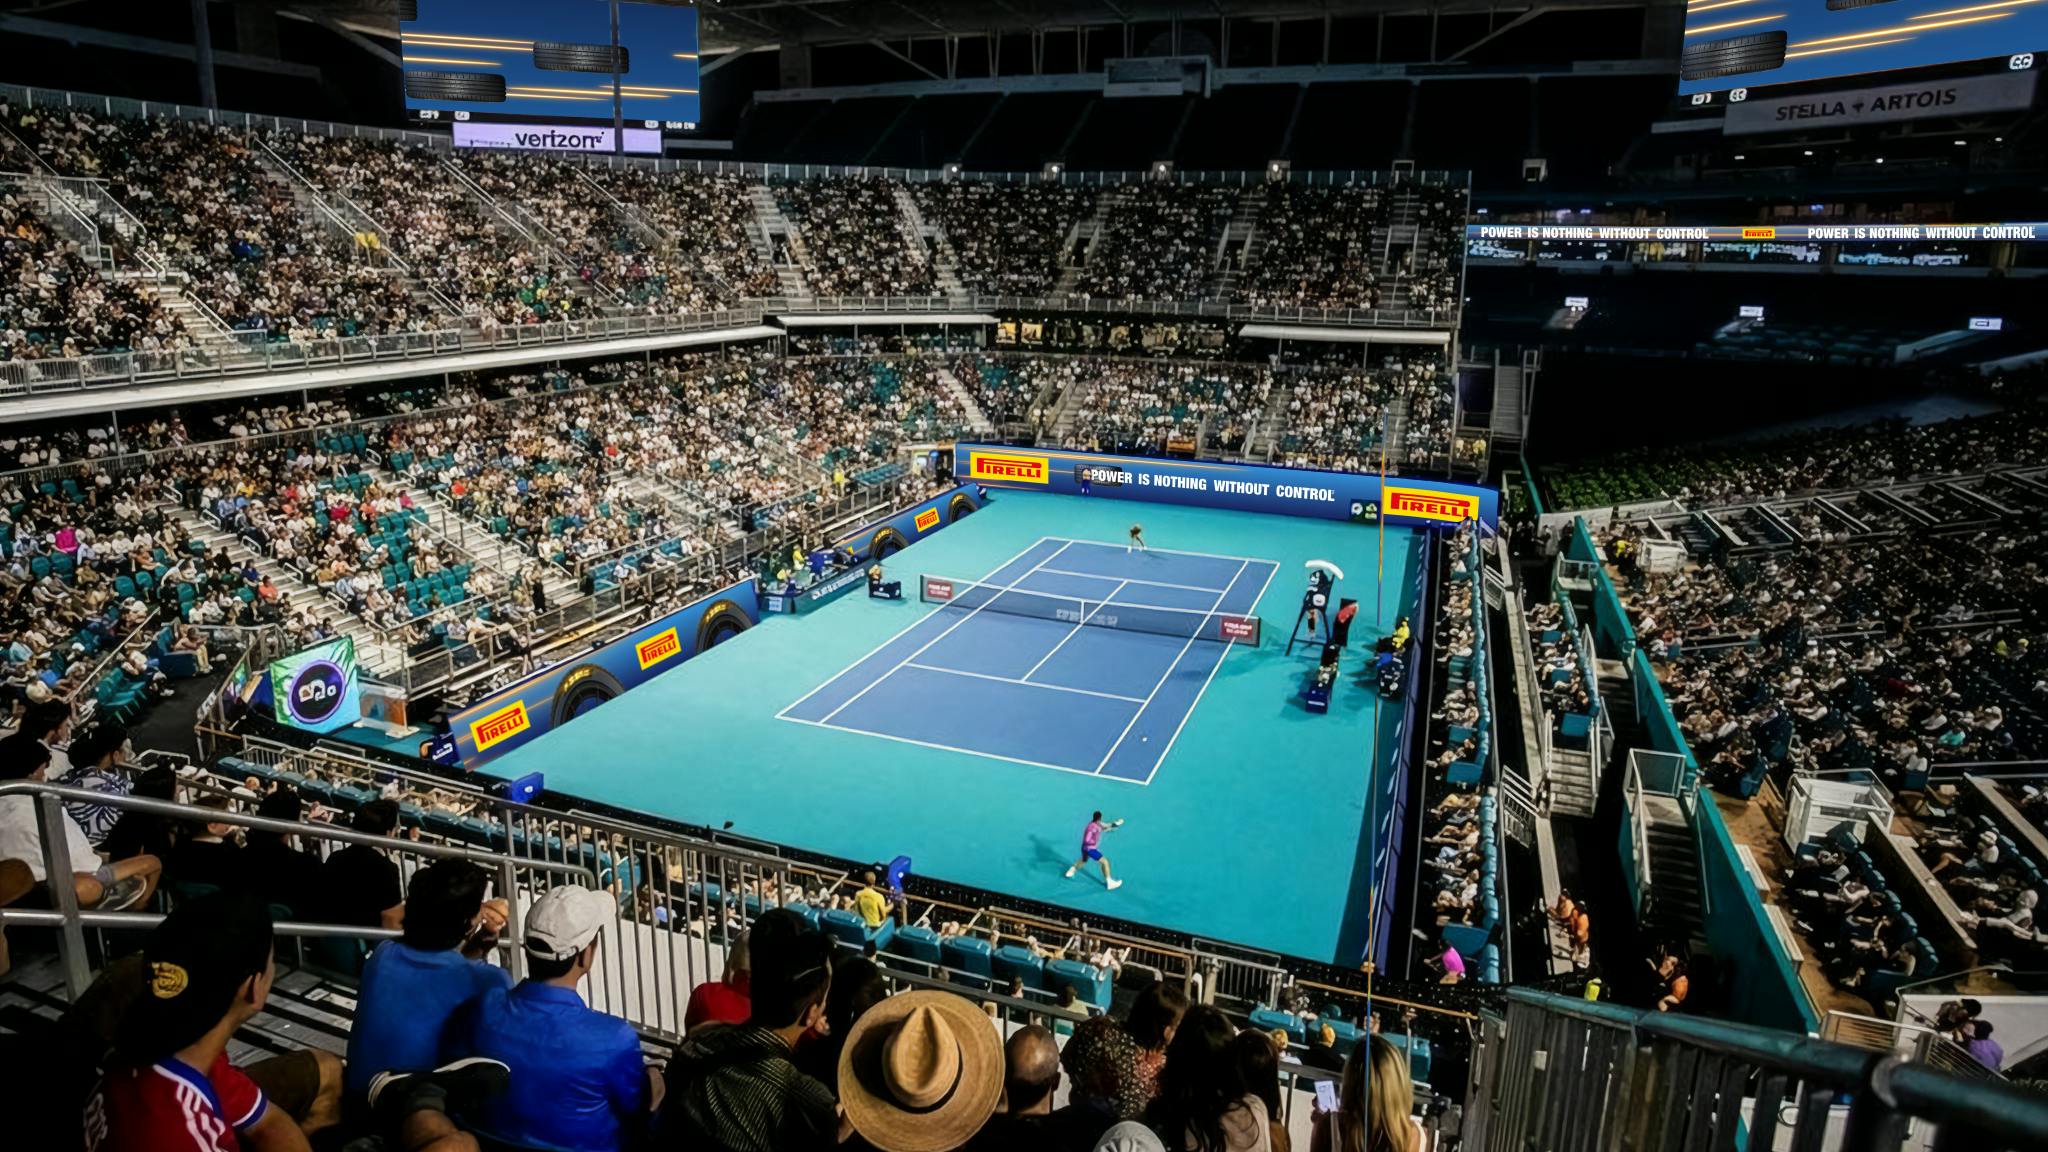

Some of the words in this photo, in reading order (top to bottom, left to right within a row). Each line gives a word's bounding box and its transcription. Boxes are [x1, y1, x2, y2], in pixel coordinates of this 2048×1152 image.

[1775, 101, 1846, 121] STELLA
[1870, 88, 1957, 113] ARTOIS
[1480, 226, 1522, 239] POWER
[1527, 226, 1539, 239] IS
[1542, 226, 1593, 239] NOTHING
[1599, 227, 1651, 239] WITHOUT
[1656, 227, 1709, 240] CONTROL
[1807, 227, 1849, 239] POWER
[1854, 227, 1866, 239] IS
[1869, 226, 1920, 239] NOTHING
[1925, 226, 1977, 239] WITHOUT
[1982, 226, 2035, 239] CONTROL
[976, 457, 1042, 479] PIRELLI
[1090, 468, 1133, 485] POWER
[1138, 473, 1150, 486] IS
[1153, 474, 1207, 491] NOTHING
[1213, 479, 1270, 497] WITHOUT
[1276, 484, 1335, 502] CONTROL
[1390, 492, 1471, 518] PIRELLI
[640, 633, 677, 664] PIRELLI
[476, 707, 524, 745] PIRELLI
